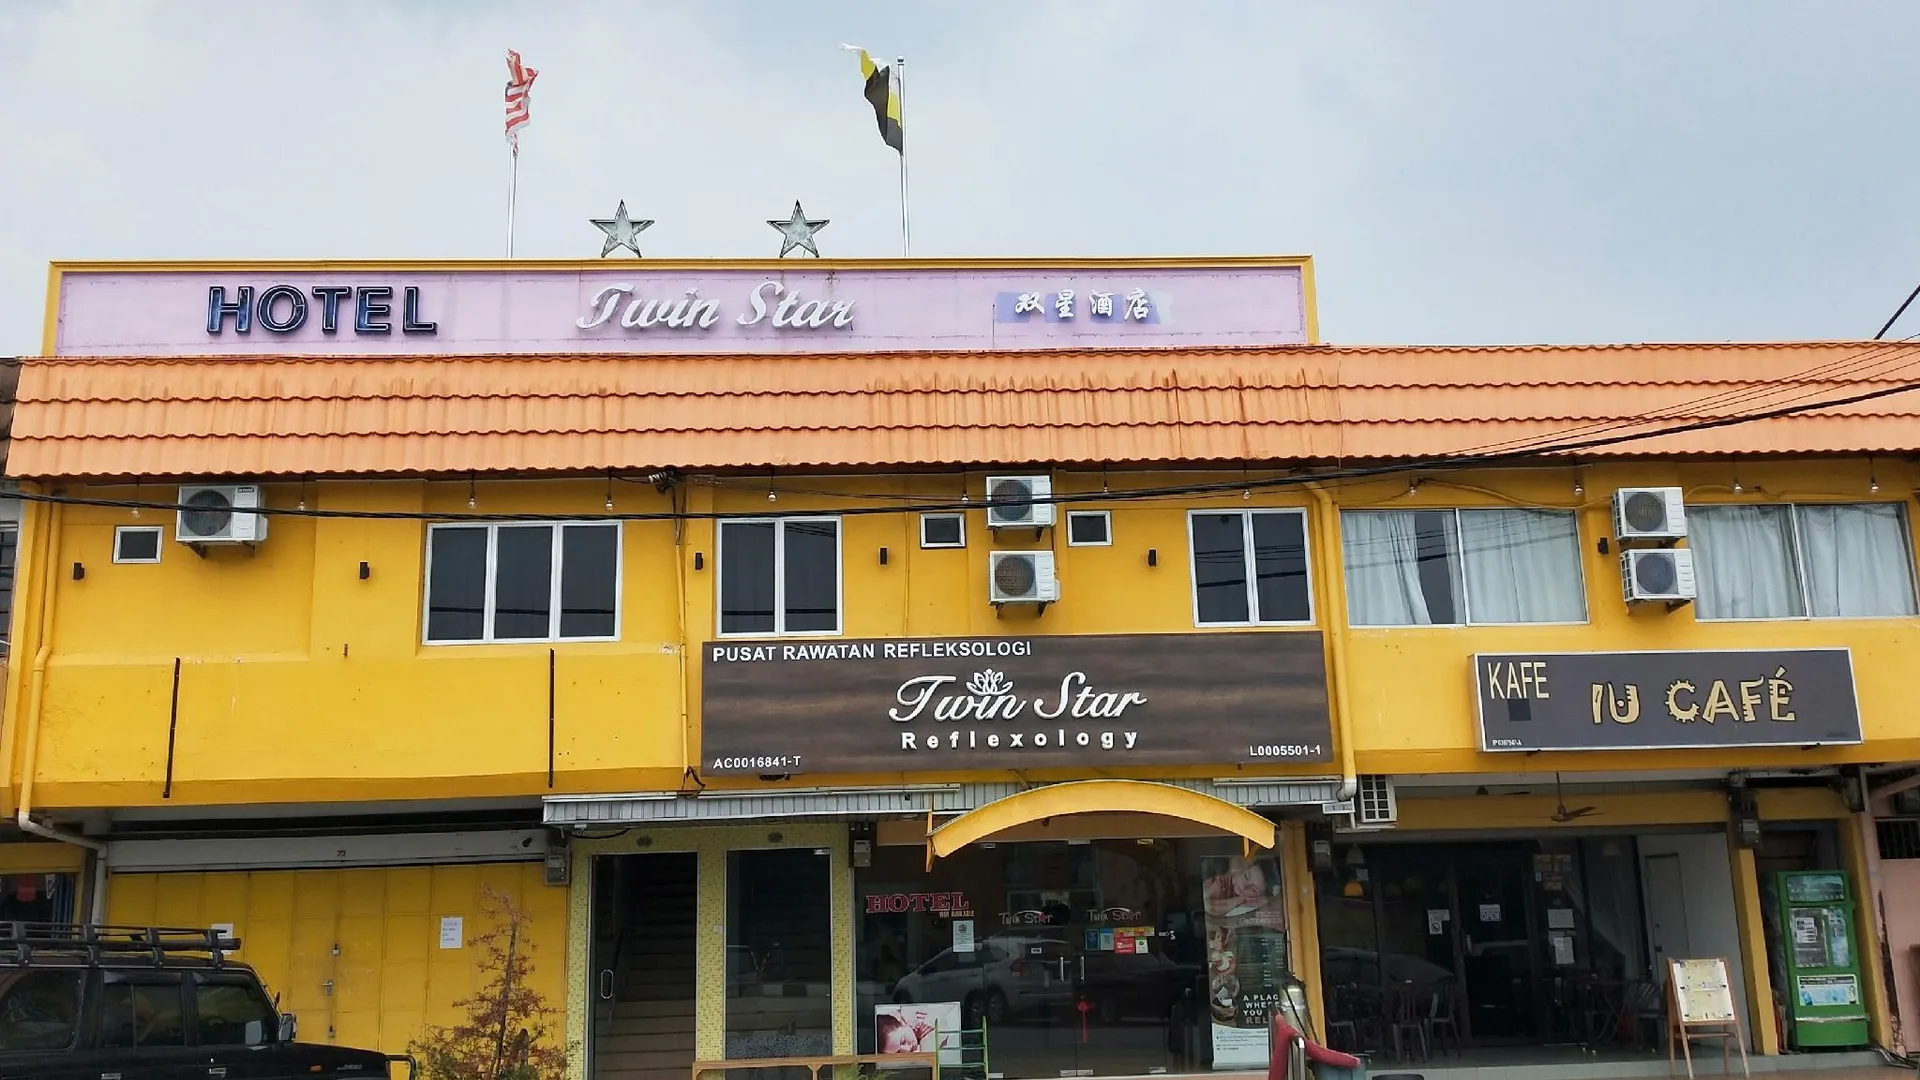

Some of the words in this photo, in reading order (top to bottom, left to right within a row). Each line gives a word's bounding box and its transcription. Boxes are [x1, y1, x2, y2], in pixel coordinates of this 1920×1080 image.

[207, 285, 437, 334] HOTEL
[577, 283, 720, 330] Twin
[737, 281, 855, 330] Star
[1015, 287, 1150, 320] 双星酒店
[713, 646, 776, 663] PUSAT
[782, 644, 875, 660] RAWATAN
[884, 641, 1032, 658] REFLEKSOLOGI
[888, 674, 1028, 722] Twin
[1034, 671, 1148, 720] Star
[1487, 661, 1550, 700] KAFE
[1591, 682, 1642, 725] IU
[1665, 666, 1796, 724] CAFÉ
[901, 729, 1139, 750] Reflexology
[1249, 744, 1322, 758] L0005501-1
[713, 755, 802, 770] AC0016841-T
[866, 892, 970, 914] HOTEL
